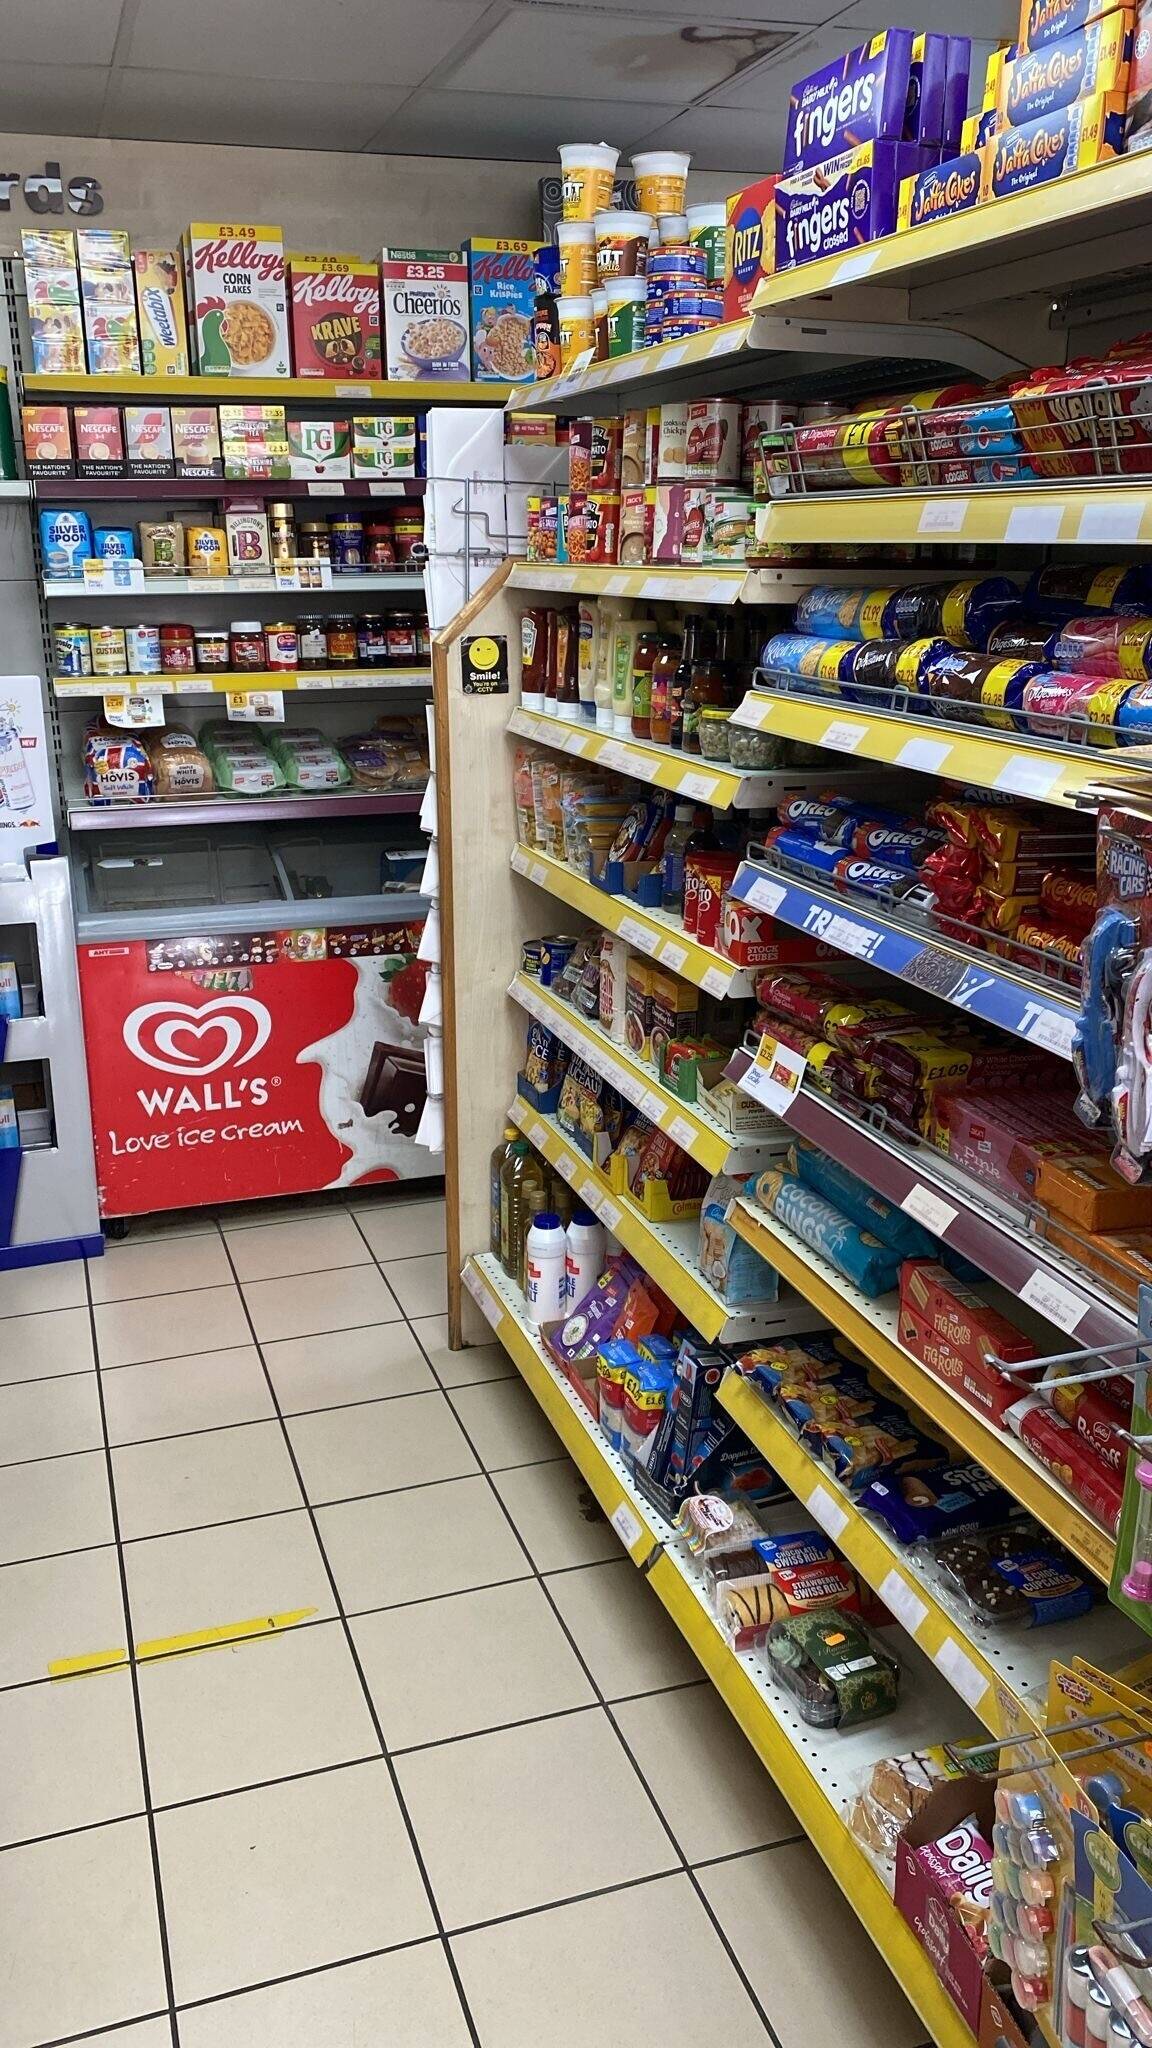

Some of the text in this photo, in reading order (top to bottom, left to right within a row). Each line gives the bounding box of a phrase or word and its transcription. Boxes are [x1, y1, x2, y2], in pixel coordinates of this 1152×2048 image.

[1098, 40, 1118, 63] £1.49
[1011, 47, 1083, 106] Jaffa Cakes
[793, 72, 876, 158] fingers
[1080, 122, 1099, 145] £1.49
[996, 128, 1066, 182] Jaffa Cakes
[823, 158, 841, 177] WIN
[914, 170, 977, 221] Jaffa Cakes
[219, 227, 256, 238] £3.49
[786, 197, 850, 258] fingers
[495, 241, 528, 252] £3.69
[734, 224, 762, 269] RITZ
[321, 263, 350, 273] £3.69
[406, 266, 445, 279] £3.25
[222, 273, 252, 285] CORN
[497, 282, 515, 291] Rice
[223, 285, 252, 295] FLAKES
[489, 290, 523, 300] Krispies
[393, 291, 461, 316] Cheerios
[147, 288, 176, 347] Weetabix
[311, 316, 361, 340] KRAVE
[248, 429, 261, 439] TEA
[378, 421, 393, 435] PG
[846, 422, 868, 447] £1
[304, 428, 333, 451] PG
[377, 451, 392, 466] PG
[252, 465, 265, 474] TEA
[49, 525, 86, 535] SILVER
[49, 534, 88, 543] SPOON
[862, 605, 882, 621] £1.99
[767, 642, 791, 665] Rich
[469, 671, 501, 681] Smile!
[233, 696, 243, 704] £1
[22, 739, 36, 747] NEW
[101, 770, 135, 783] HOVIS
[174, 777, 199, 786] HOVIS
[788, 800, 838, 818] OREO
[867, 829, 926, 847] OREO
[847, 862, 906, 881] OREO
[1110, 847, 1146, 879] RACING
[1119, 876, 1145, 897] CARS
[747, 944, 779, 954] STOCK
[747, 953, 779, 964] CUBES
[928, 1063, 970, 1081] £1.09
[109, 1129, 170, 1156] Love
[177, 1126, 216, 1148] ice
[963, 1146, 1001, 1179] Pink
[781, 1183, 858, 1229] COCONUT
[775, 1196, 827, 1248] RINGS
[934, 1313, 971, 1346] FIG ROLLS
[923, 1344, 963, 1377] FIG ROLLS
[774, 1551, 827, 1570] SWISS ROLL
[776, 1545, 818, 1559] CHOCOLATE
[1032, 1567, 1060, 1579] CHOC
[792, 1575, 840, 1591] STRAWBERRY
[793, 1581, 848, 1601] SWISS ROLL
[1022, 1574, 1072, 1592] CUPCAKES
[919, 1844, 952, 1880] croissant
